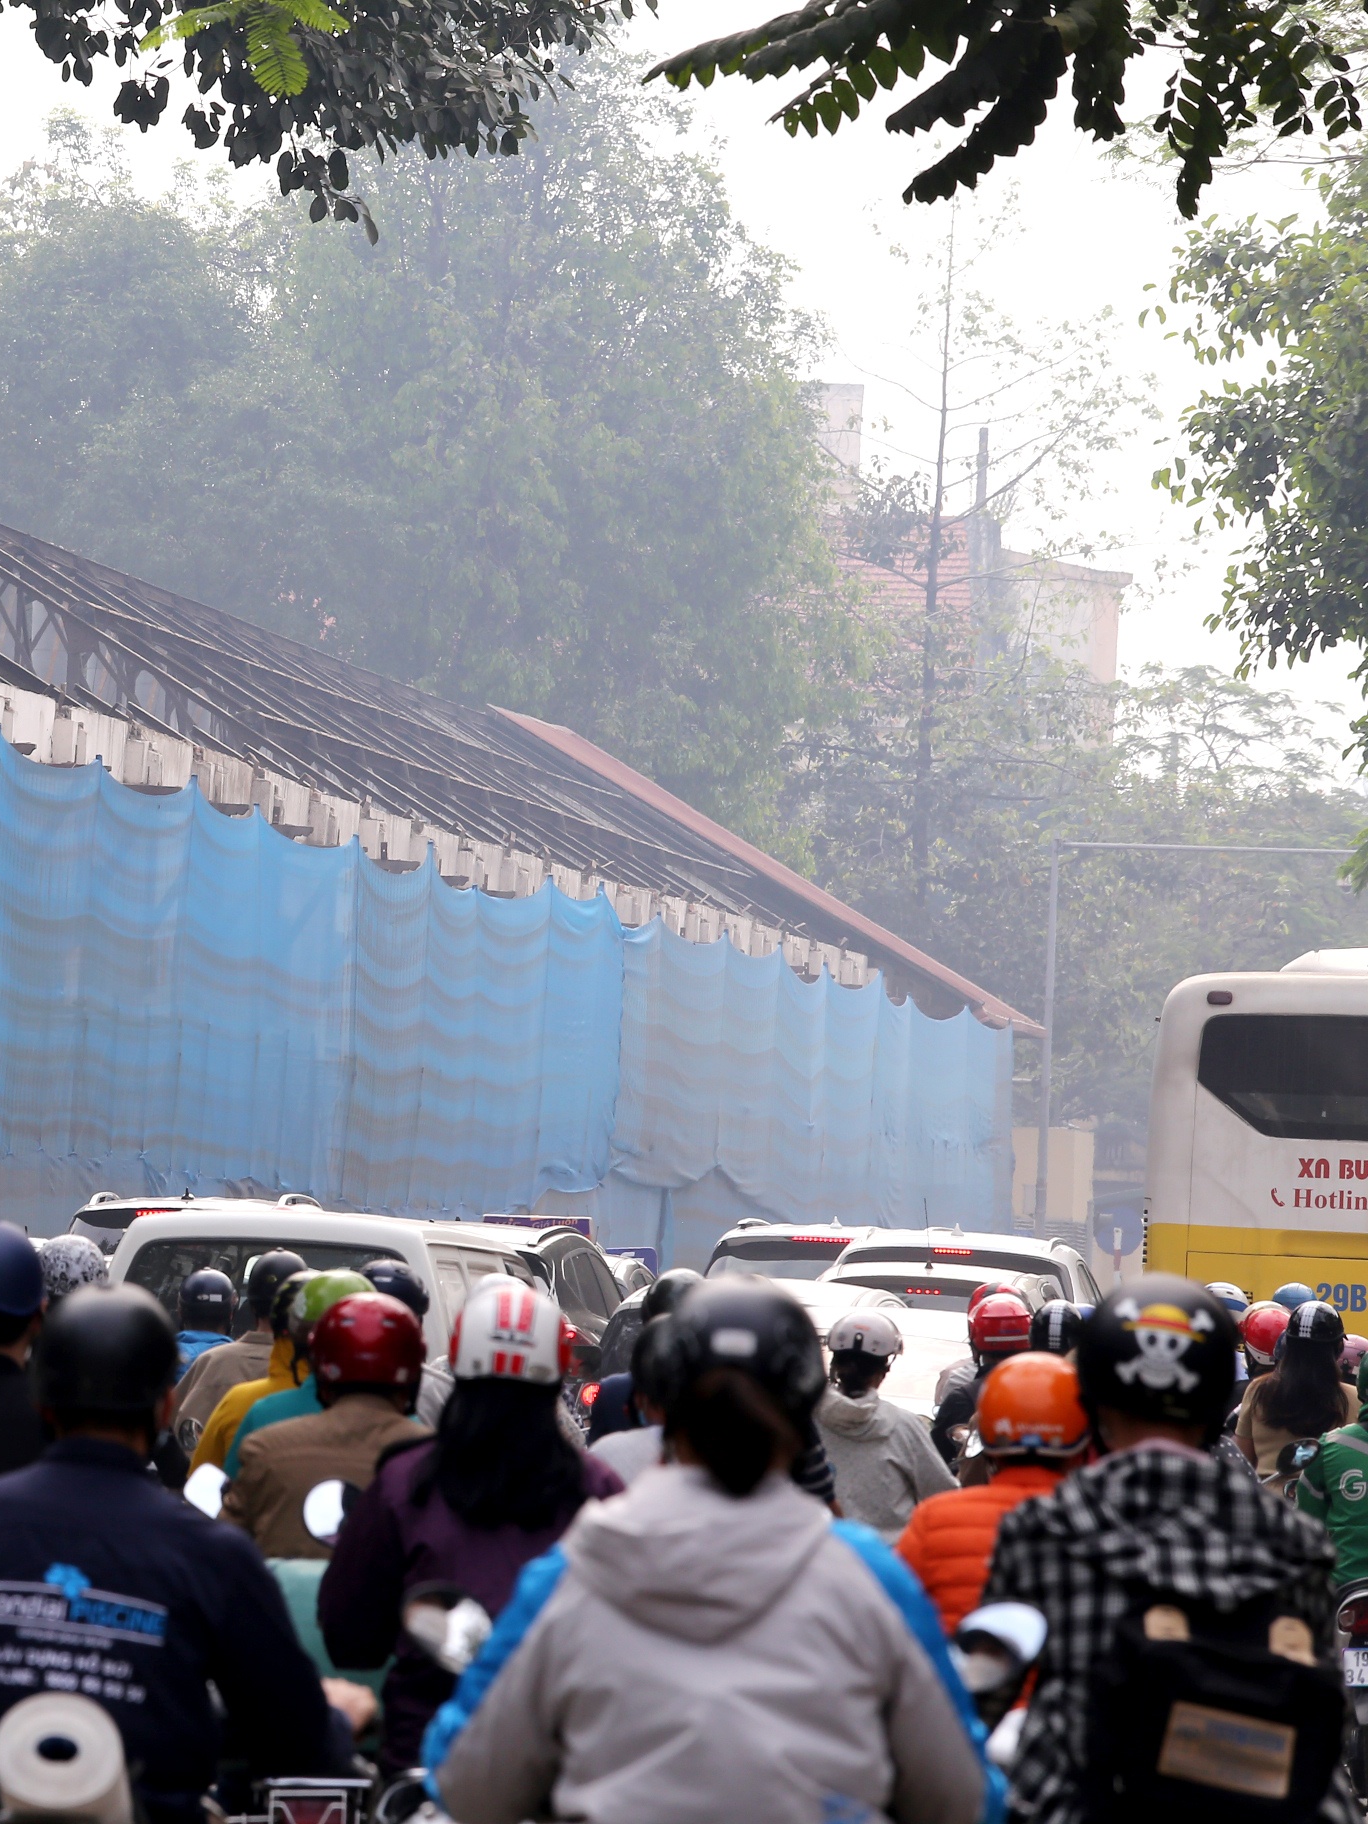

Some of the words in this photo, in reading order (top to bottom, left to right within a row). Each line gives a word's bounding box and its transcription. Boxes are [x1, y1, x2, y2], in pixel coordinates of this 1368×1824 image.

[1297, 1157, 1330, 1179] XN
[1292, 1187, 1368, 1211] Hotlin
[1316, 1282, 1367, 1312] 29B
